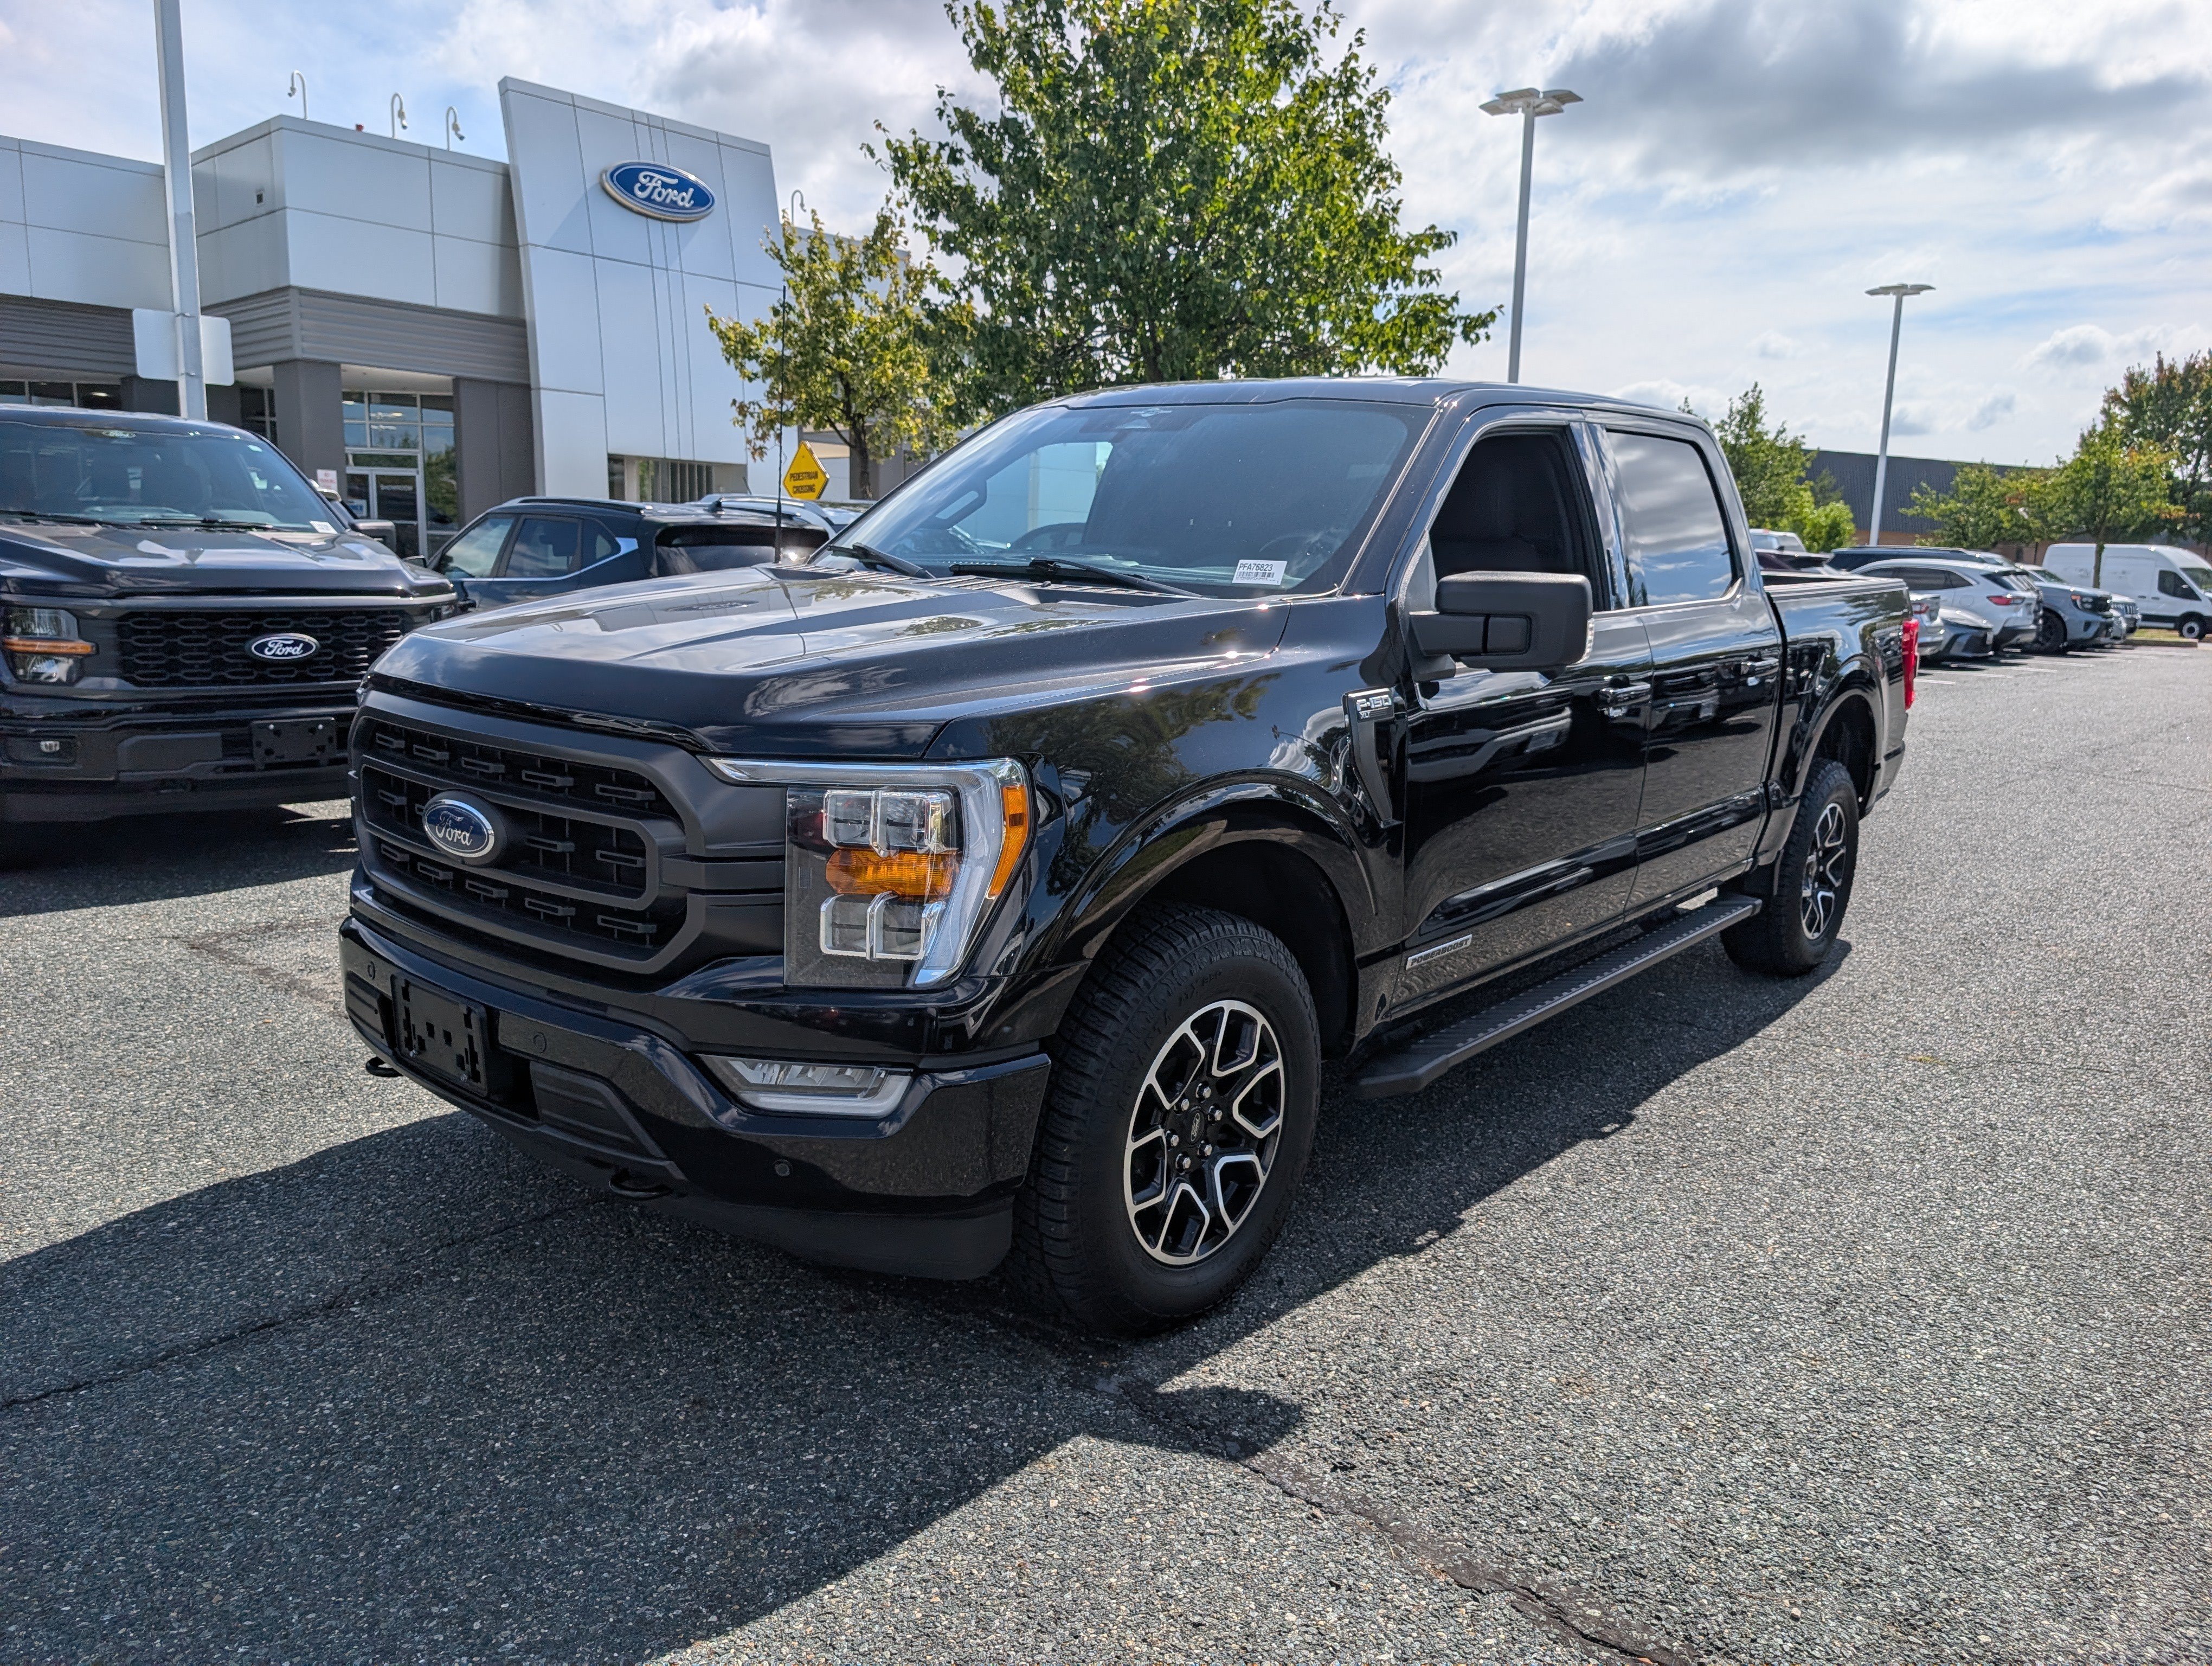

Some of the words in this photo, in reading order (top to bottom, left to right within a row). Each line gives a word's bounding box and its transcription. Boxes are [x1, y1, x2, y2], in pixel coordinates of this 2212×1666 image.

[633, 171, 695, 208] Ford
[790, 470, 819, 482] PEDESTRIAN
[793, 484, 816, 494] CROSSING
[1238, 563, 1274, 572] PFA76823
[264, 639, 304, 656] Ford
[1356, 694, 1392, 711] F-150
[1359, 711, 1371, 720] XLT
[435, 810, 473, 846] Ford
[1410, 939, 1469, 966] POWERBOOST
